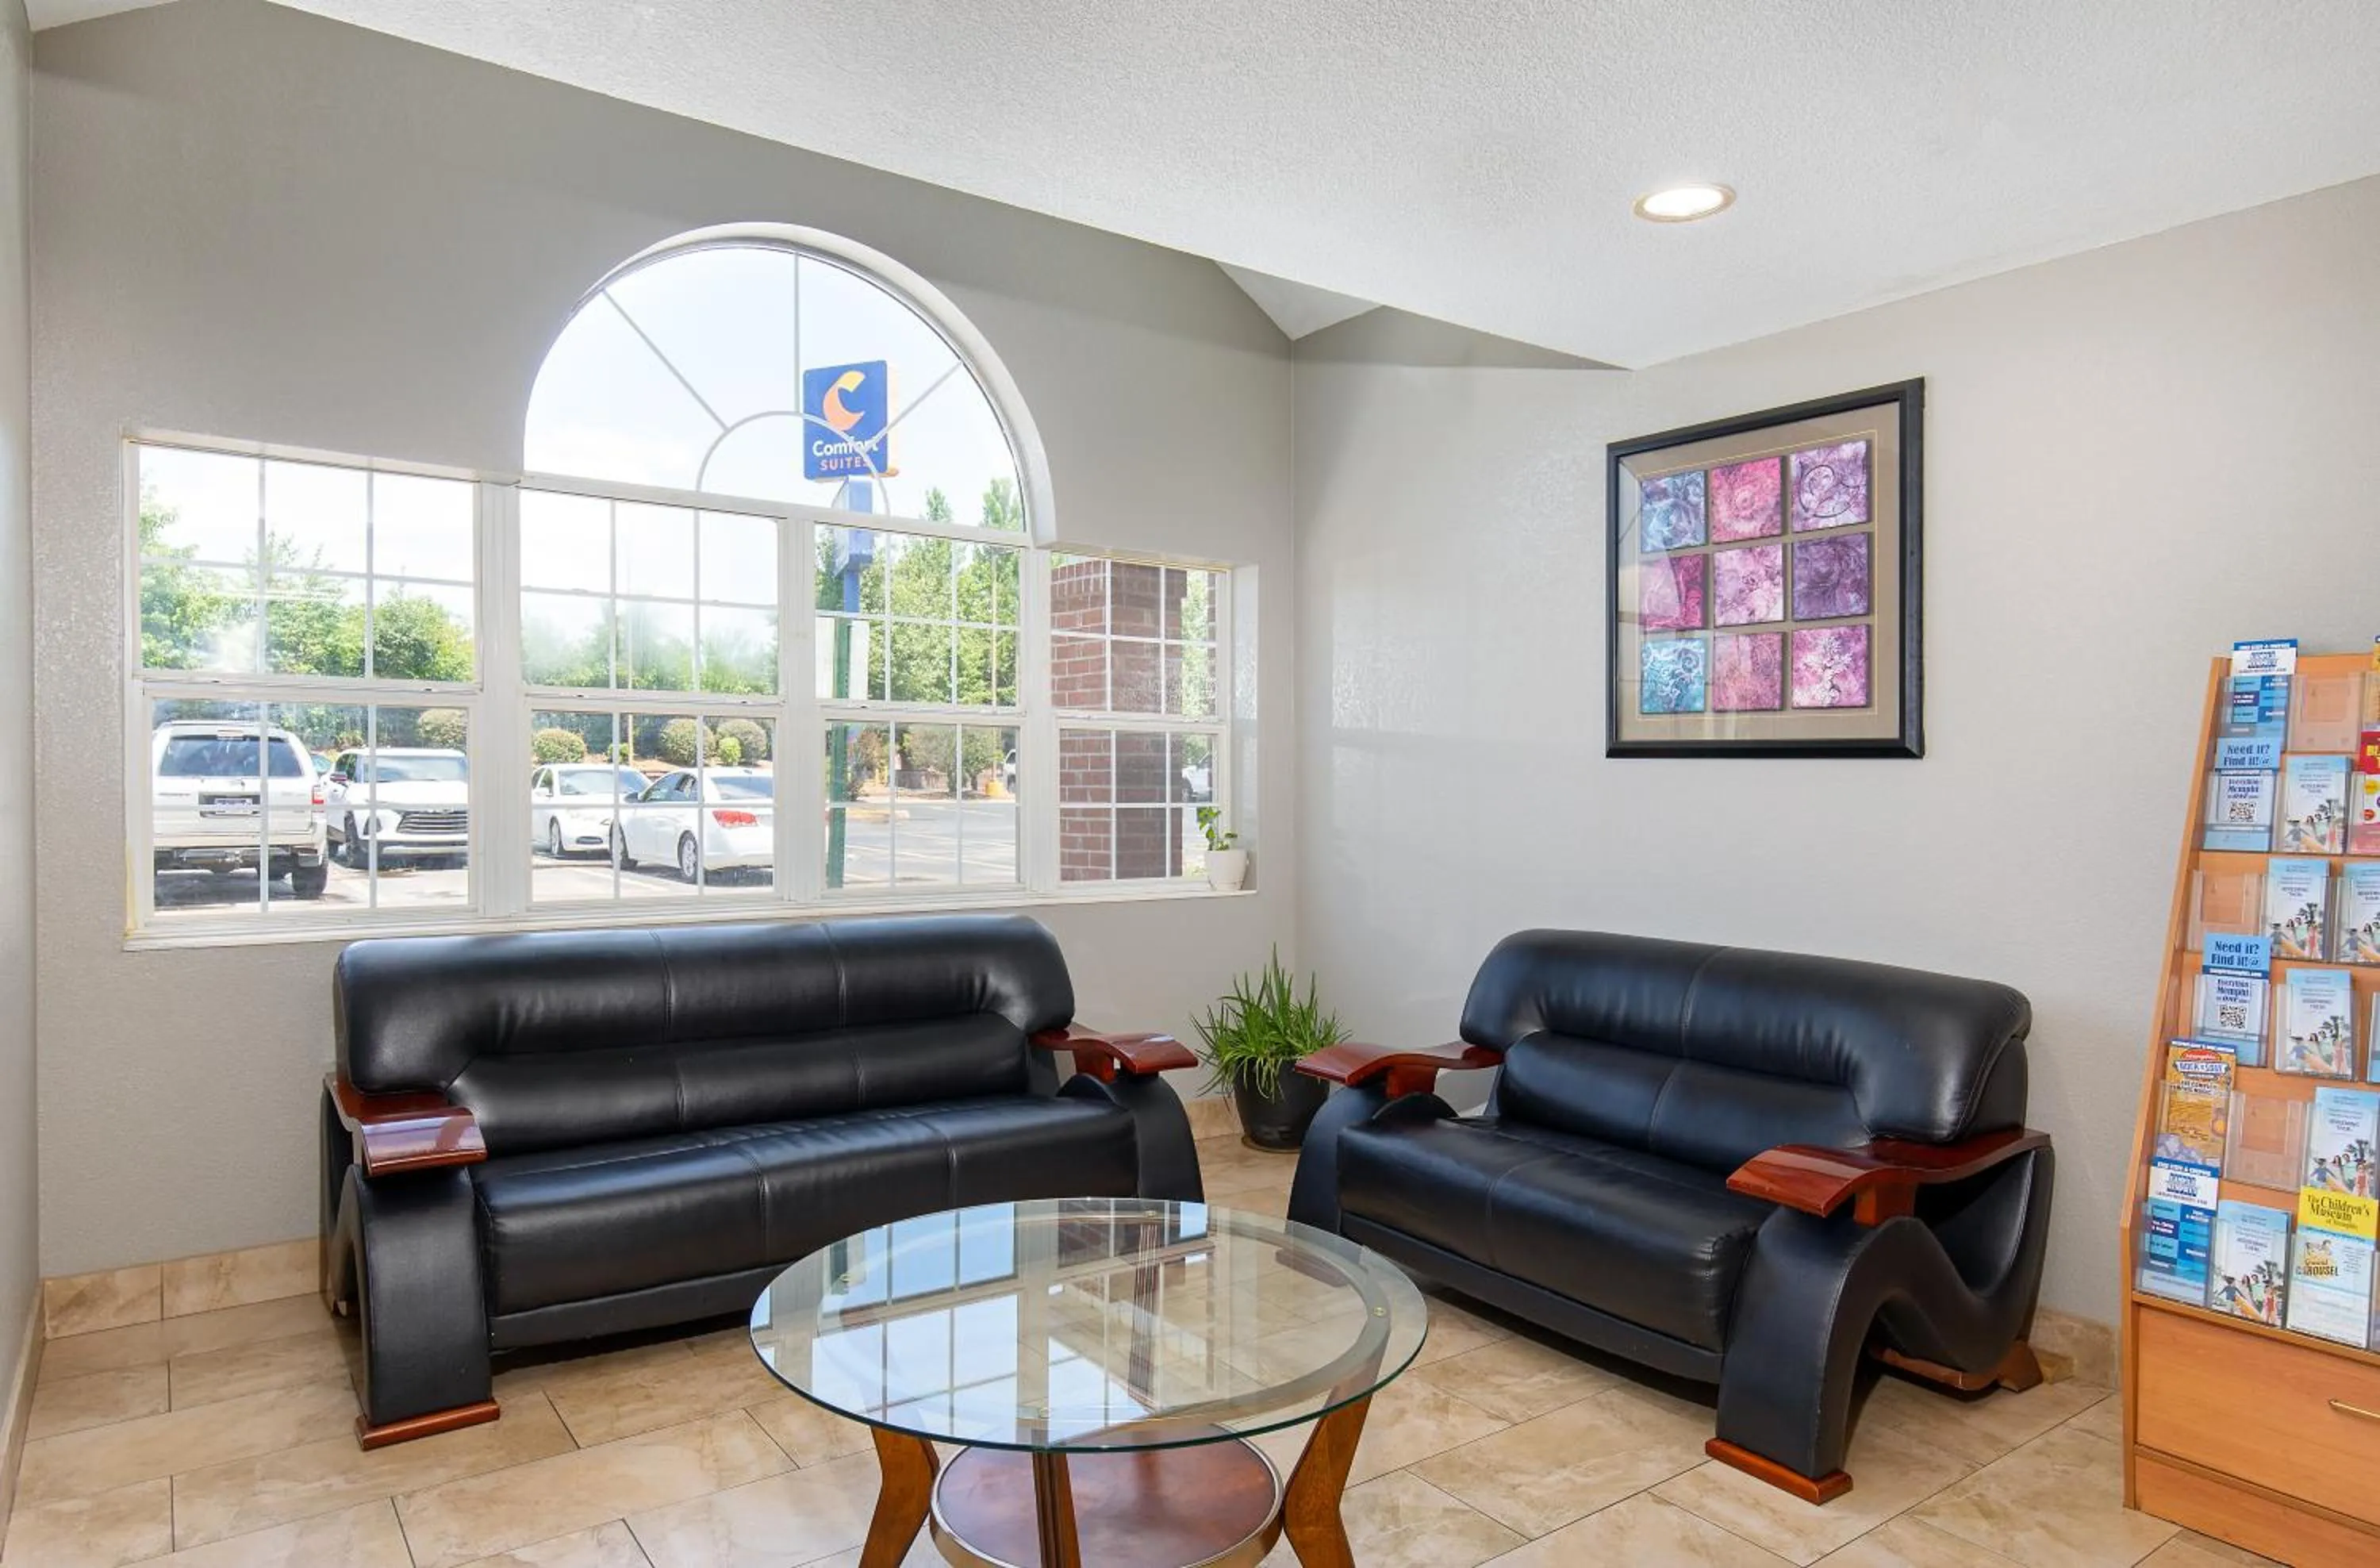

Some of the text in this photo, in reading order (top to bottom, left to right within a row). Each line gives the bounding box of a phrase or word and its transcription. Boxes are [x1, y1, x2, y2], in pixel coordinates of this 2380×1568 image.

[820, 456, 871, 471] SUITE
[2215, 940, 2241, 953] Need
[2211, 953, 2235, 966] Find
[2310, 1203, 2352, 1222] Museum
[2320, 1196, 2370, 1216] Children's
